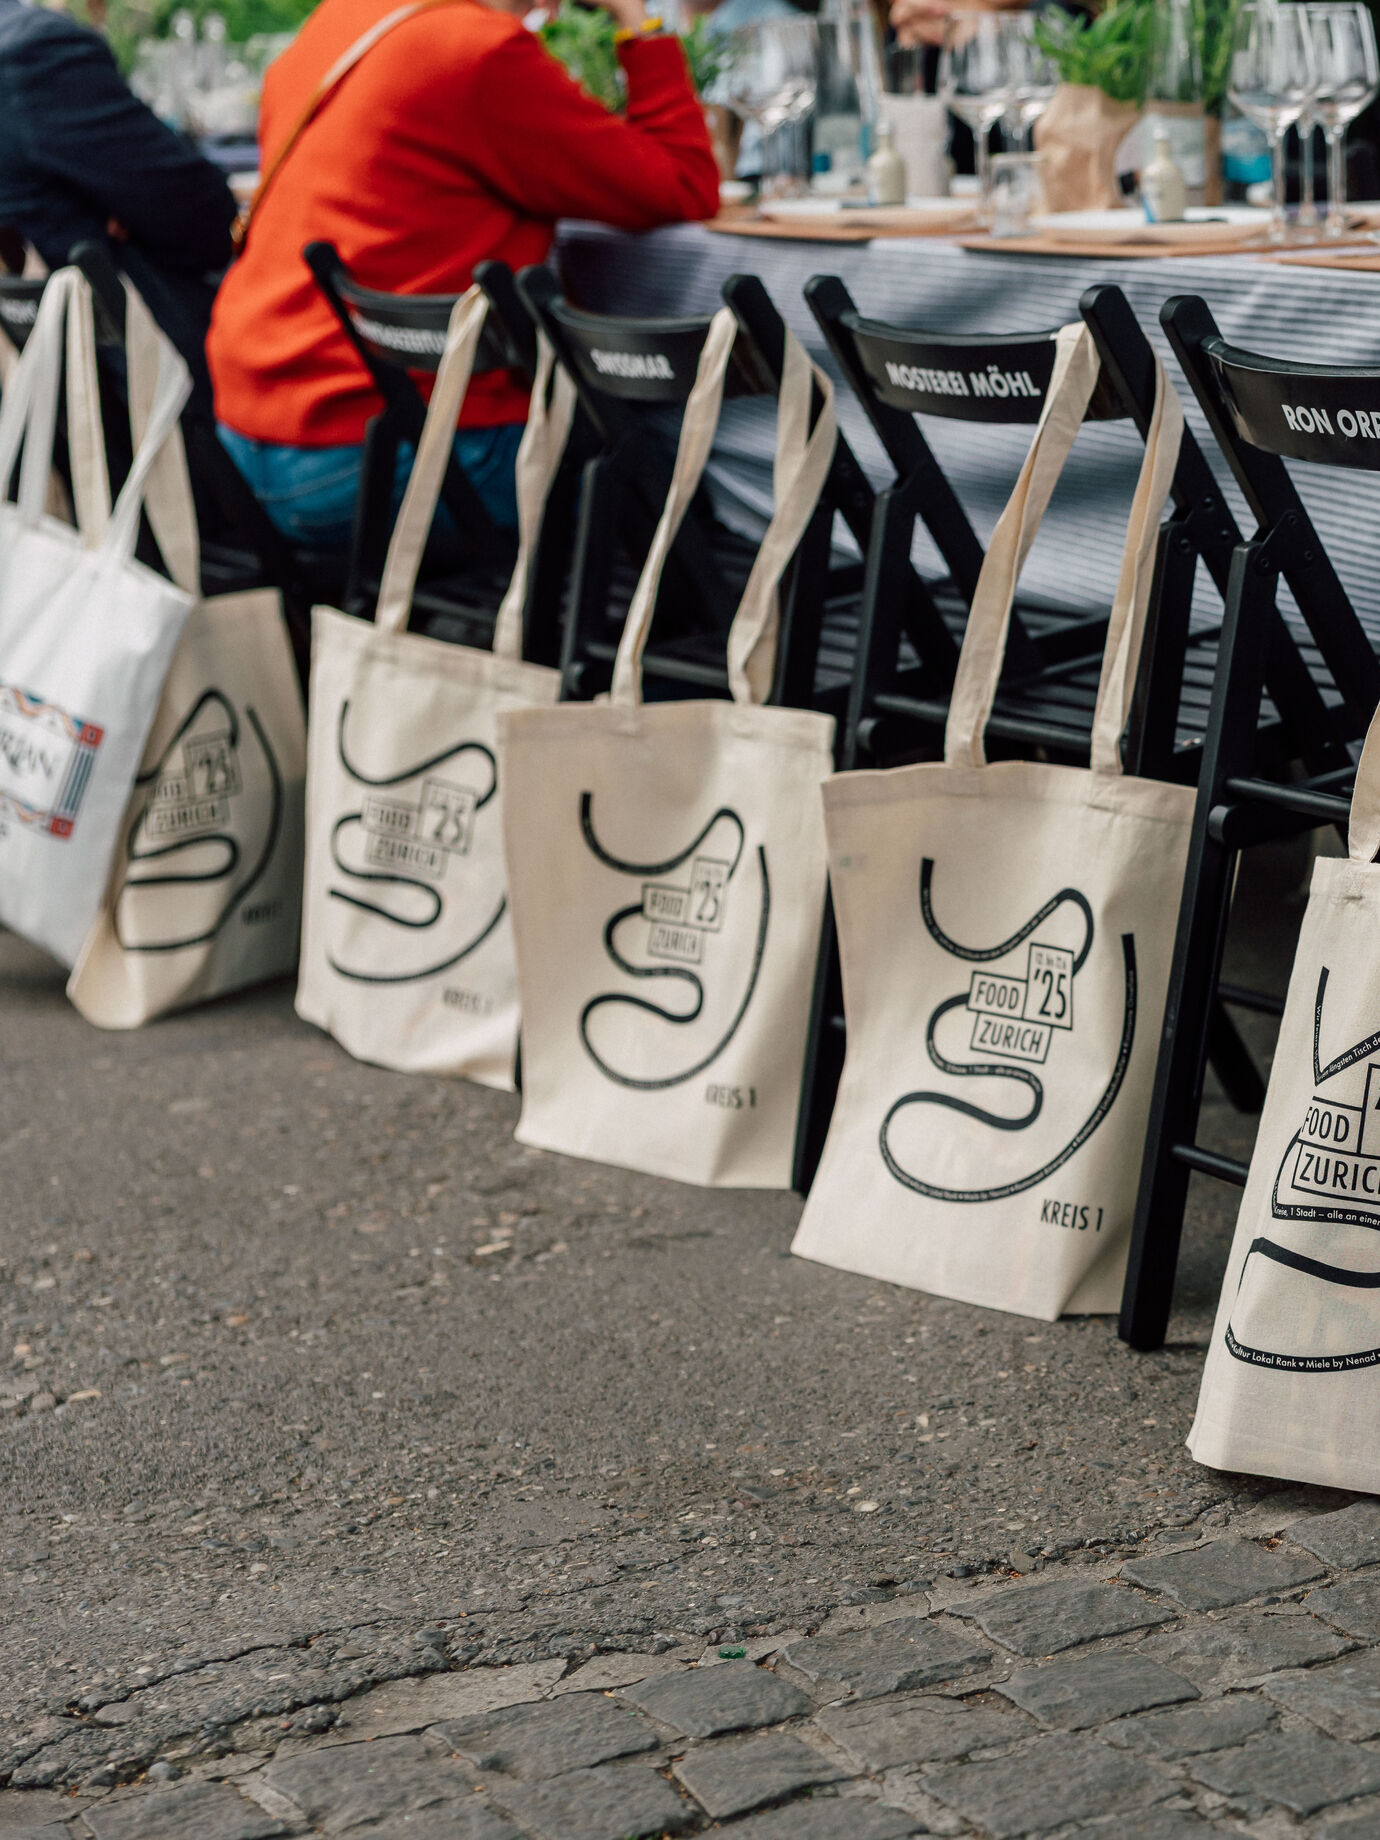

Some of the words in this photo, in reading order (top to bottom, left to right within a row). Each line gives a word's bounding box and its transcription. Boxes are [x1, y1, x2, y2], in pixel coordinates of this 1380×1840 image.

[885, 361, 969, 396] MOSTEREI
[969, 364, 1041, 398] MÖHL
[1281, 404, 1335, 435] RON
[976, 981, 1019, 1010] FOOD
[1034, 969, 1067, 1019] '25
[979, 1021, 1043, 1054] ZURICH
[1353, 1043, 1372, 1058] Tisch
[1302, 1106, 1350, 1143] FOOD
[1040, 1199, 1089, 1230] KREIS
[1096, 1208, 1103, 1232] 1
[1295, 1207, 1316, 1217] Stadt
[1327, 1210, 1344, 1220] alle
[1346, 1214, 1357, 1222] an
[1252, 1352, 1274, 1365] Lokal
[1276, 1356, 1297, 1368] Rank
[1305, 1359, 1331, 1369] Miele
[1333, 1359, 1344, 1370] by
[1346, 1353, 1376, 1366] Nenad
